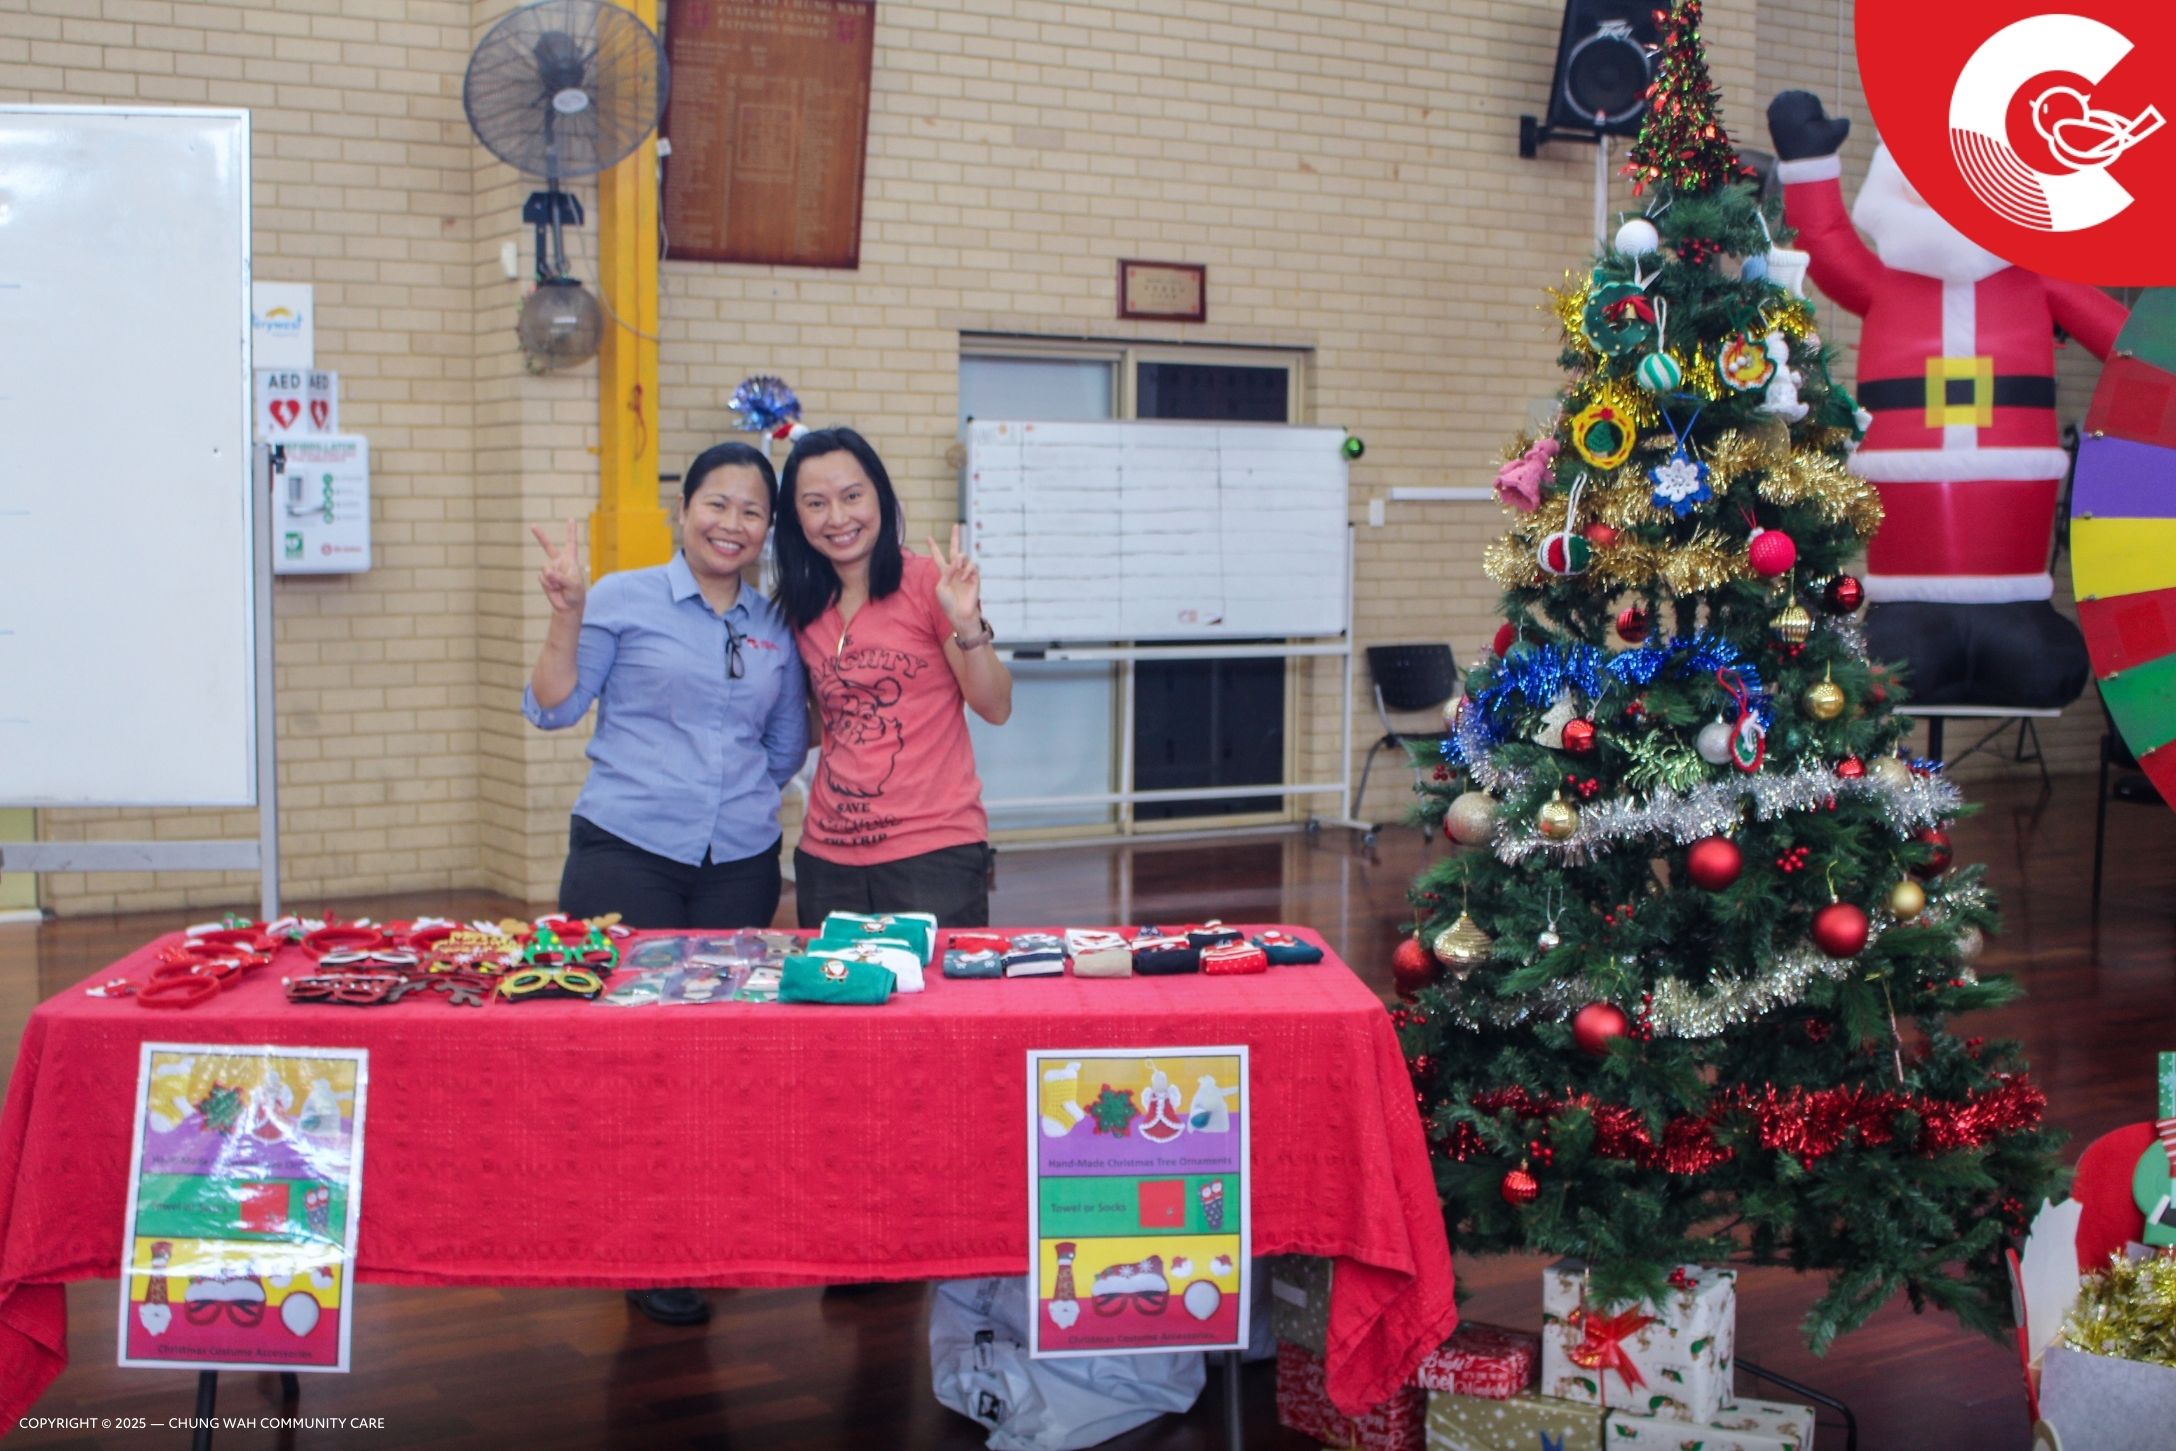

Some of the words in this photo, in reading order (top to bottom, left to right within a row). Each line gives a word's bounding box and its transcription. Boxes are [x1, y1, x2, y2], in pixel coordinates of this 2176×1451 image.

[268, 374, 301, 389] AED
[309, 373, 330, 390] AED
[836, 802, 871, 814] SAVE
[852, 833, 888, 847] TRIP
[1048, 1157, 1105, 1169] Hand-Made
[1107, 1157, 1155, 1168] Christmas
[1157, 1156, 1177, 1167] Tree
[1179, 1155, 1233, 1167] Ornaments
[1050, 1201, 1082, 1213] Towel
[1083, 1204, 1095, 1213] or
[1097, 1201, 1128, 1213] Socks
[1067, 1334, 1115, 1345] Christmas
[1117, 1333, 1158, 1345] Costume
[158, 1343, 206, 1356] Christmas
[209, 1346, 252, 1358] Costume
